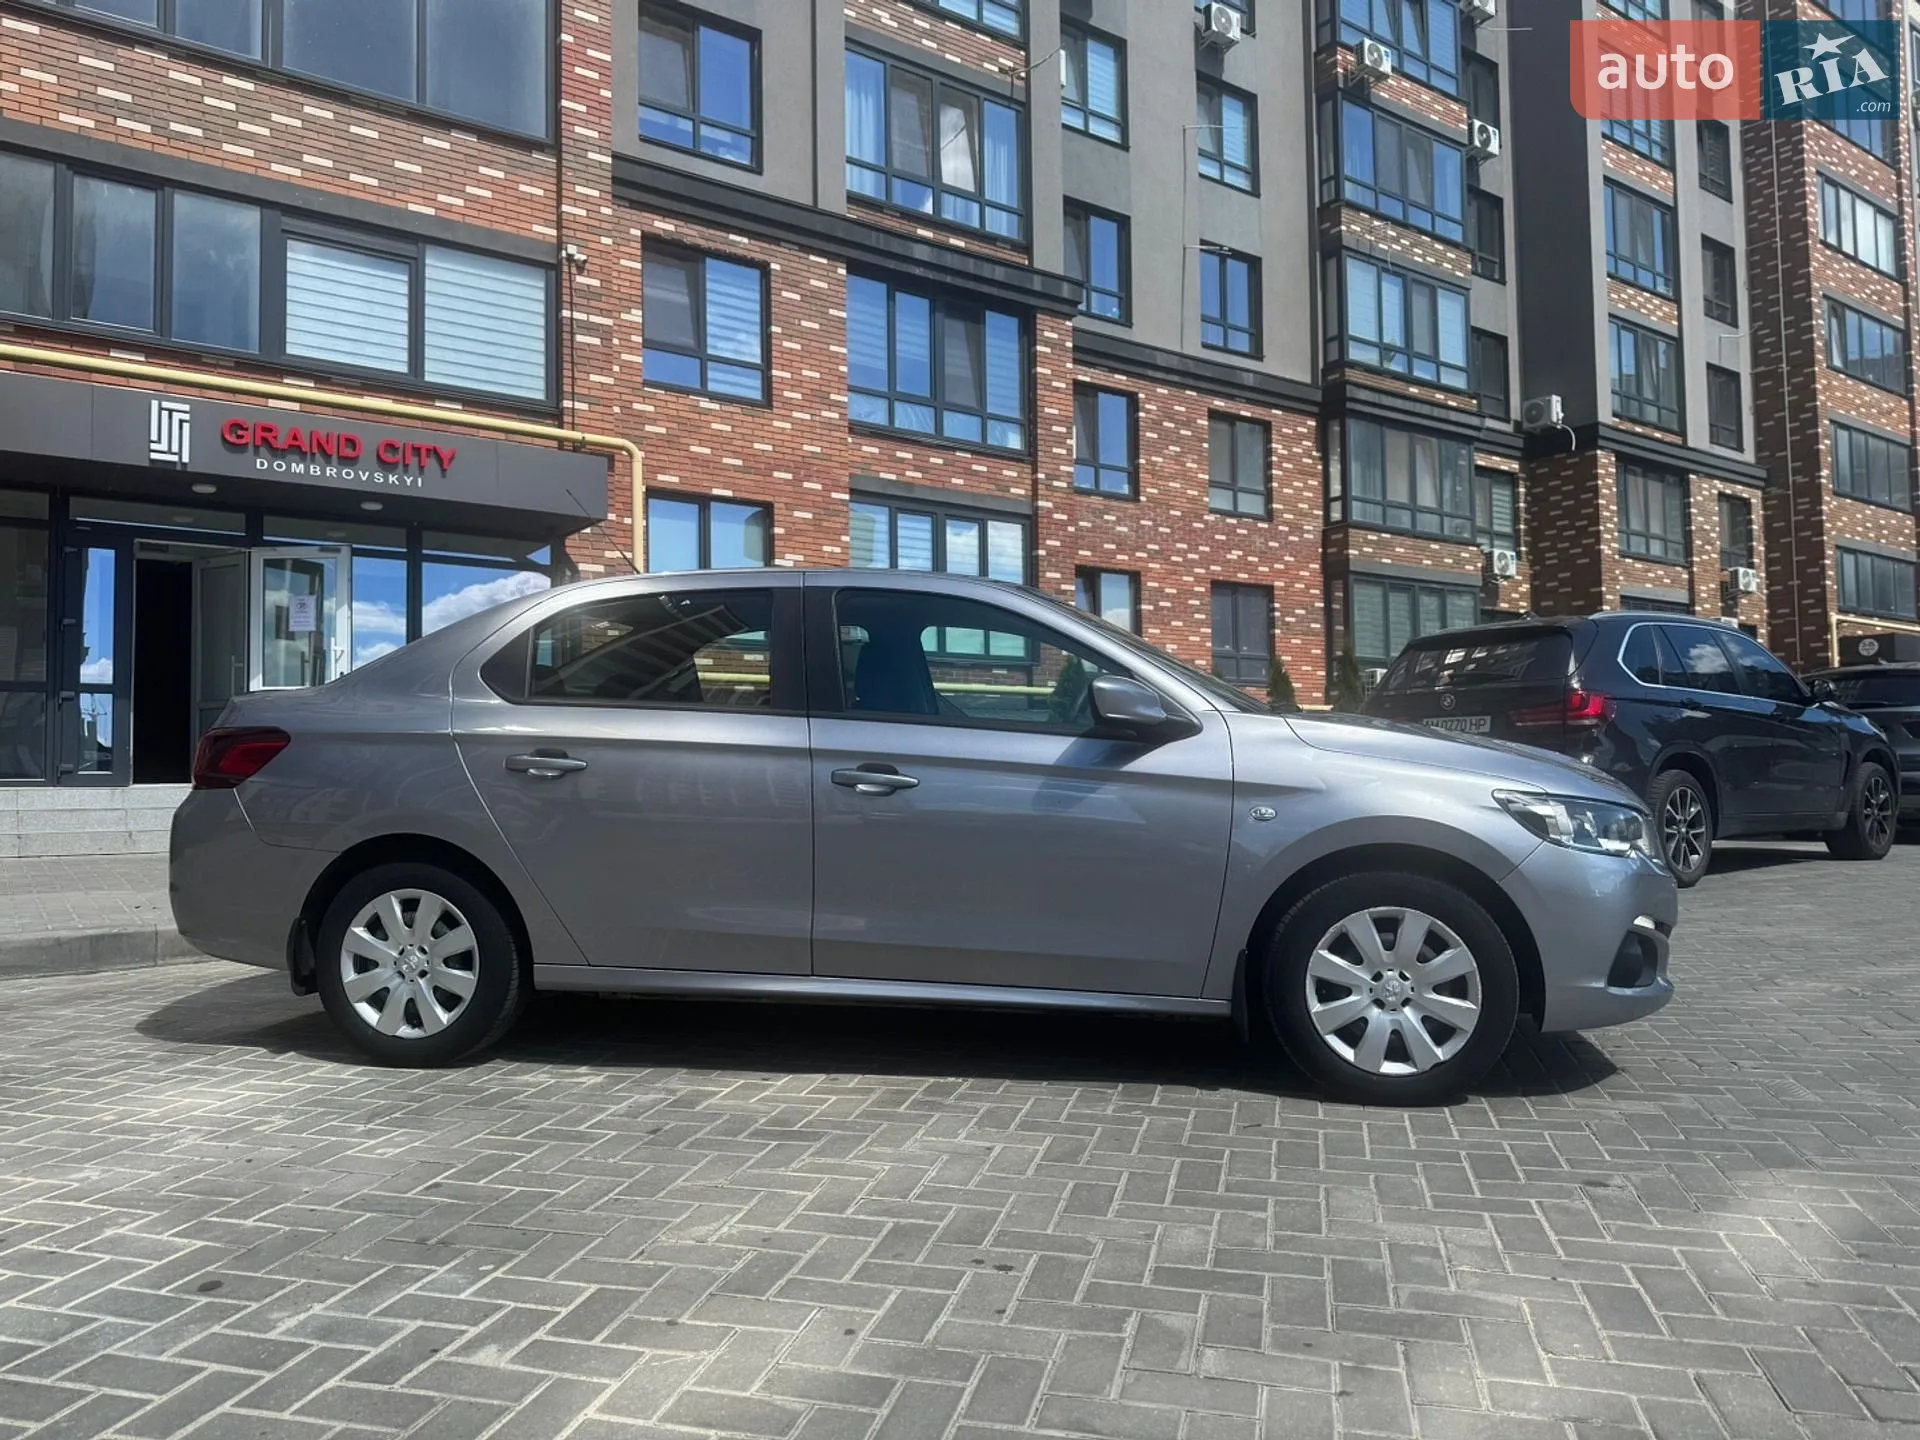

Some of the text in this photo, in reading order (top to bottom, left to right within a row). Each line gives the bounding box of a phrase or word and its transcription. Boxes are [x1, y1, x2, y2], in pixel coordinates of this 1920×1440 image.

[221, 418, 457, 472] GRAND CITY
[256, 458, 423, 488] DOMBROVSKYI
[1469, 718, 1486, 732] HP
